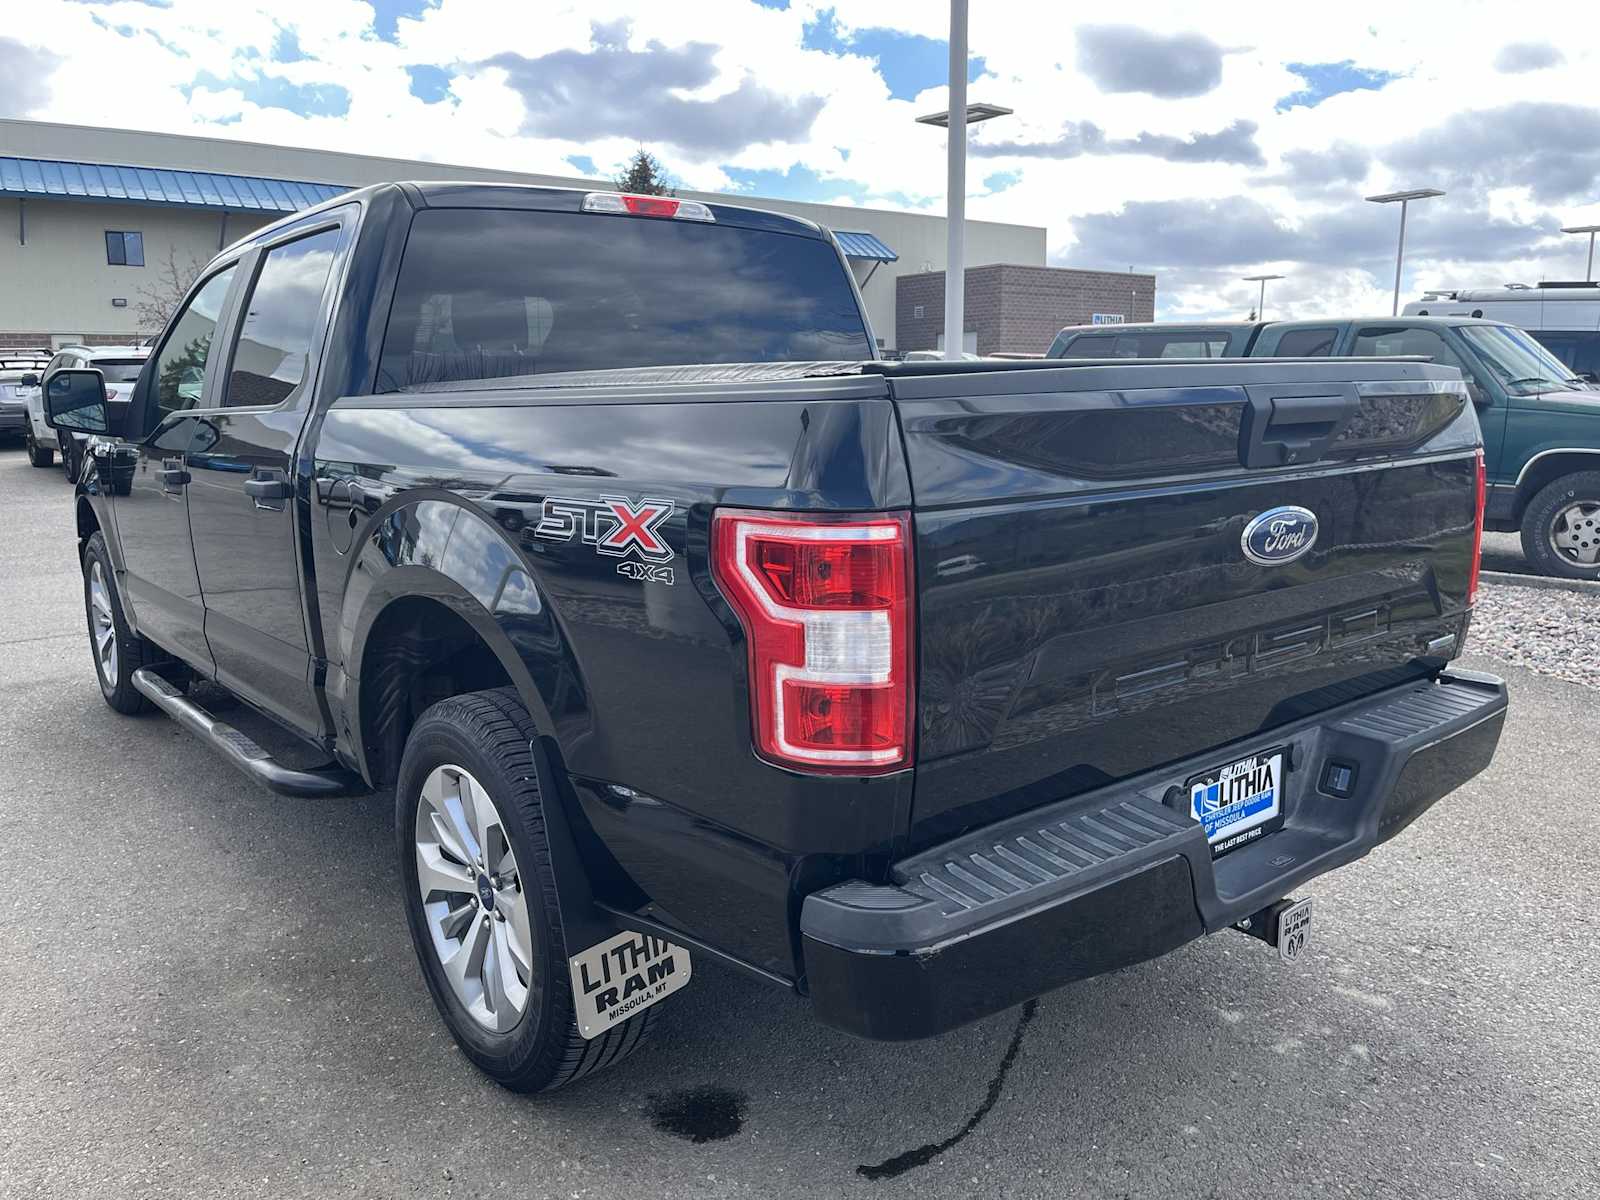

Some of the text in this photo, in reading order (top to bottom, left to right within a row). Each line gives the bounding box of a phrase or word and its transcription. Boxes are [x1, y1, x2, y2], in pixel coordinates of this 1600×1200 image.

[1101, 315, 1122, 325] LITHIA
[535, 494, 675, 563] STX
[1265, 519, 1306, 553] Ford
[1229, 757, 1257, 777] LITHIA
[1219, 764, 1274, 807] LITHIA
[1204, 810, 1246, 833] OF MISSOULA
[1205, 806, 1231, 822] CHRYSLER
[1232, 802, 1245, 813] JEEP
[1214, 827, 1262, 852] THE LAST BEST PRICE
[1284, 917, 1310, 937] RAM
[1285, 907, 1309, 927] LITHIA
[595, 955, 676, 1014] RAM
[608, 983, 667, 1021] MISSOULA, MT
